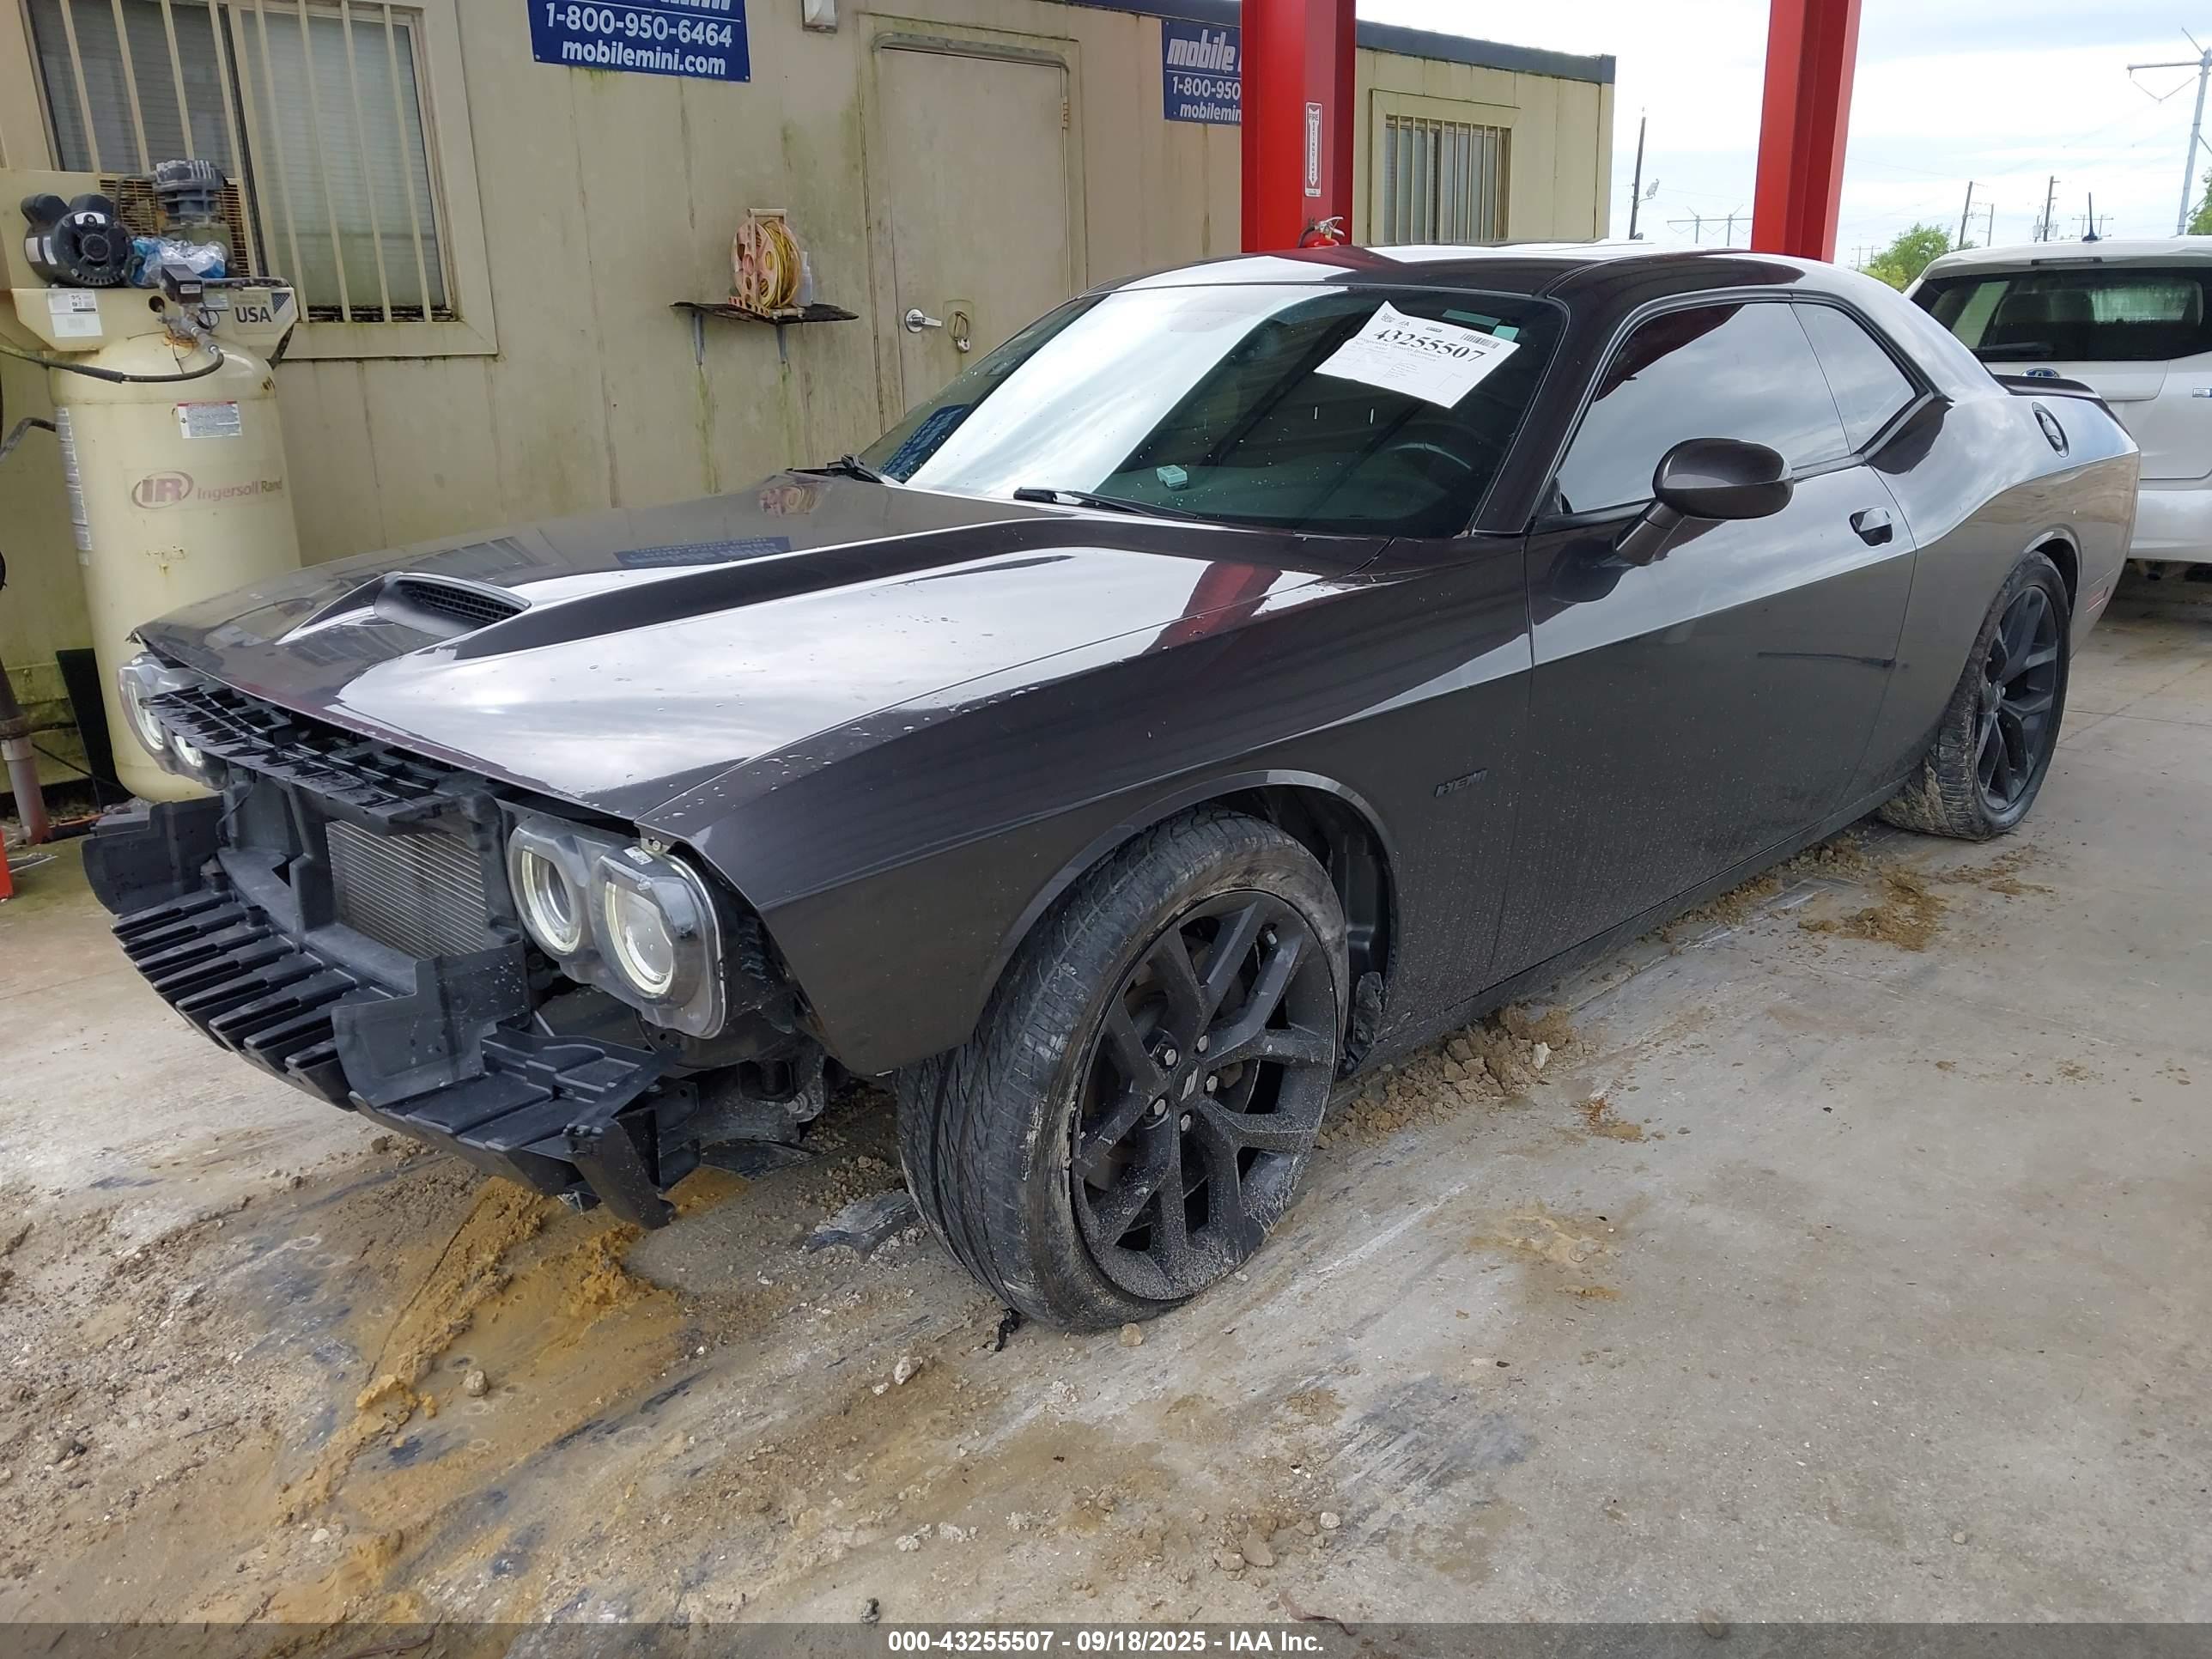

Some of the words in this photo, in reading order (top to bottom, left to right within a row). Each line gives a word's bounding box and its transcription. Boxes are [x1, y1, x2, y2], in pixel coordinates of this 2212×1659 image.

[545, 3, 732, 47] 1-800-950-6464
[562, 40, 726, 75] mobilemini.com
[1167, 29, 1236, 70] mobile
[234, 306, 272, 323] USA
[1374, 329, 1487, 362] 43255507
[198, 481, 258, 501] Ingersoll
